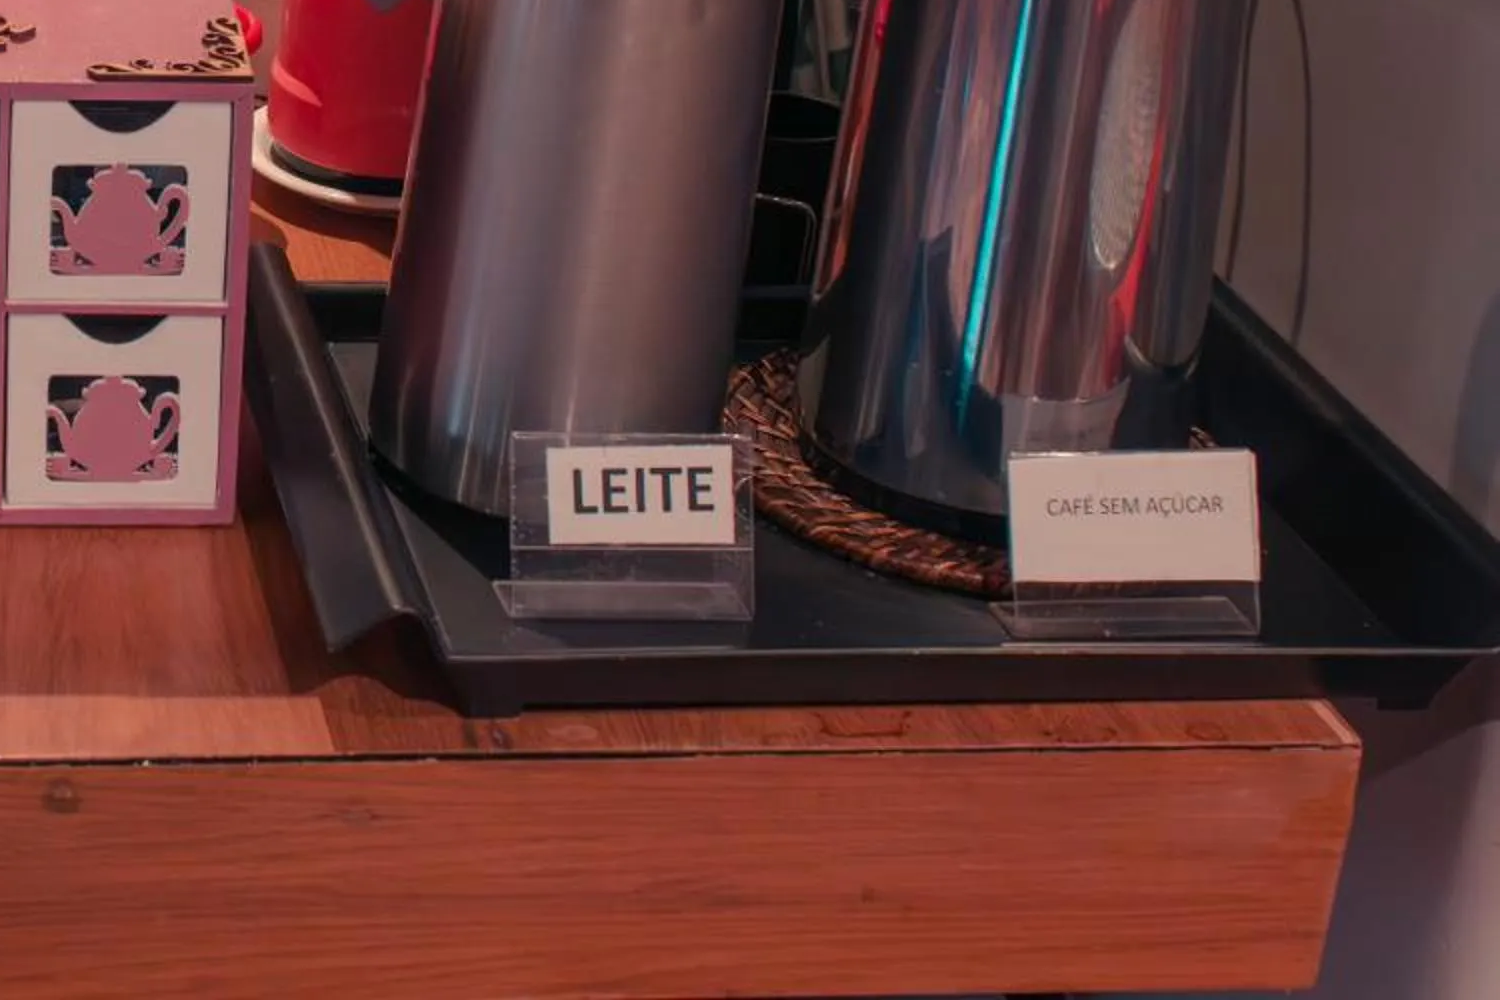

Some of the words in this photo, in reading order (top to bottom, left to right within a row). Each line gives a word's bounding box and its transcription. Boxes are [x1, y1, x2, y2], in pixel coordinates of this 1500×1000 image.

[572, 466, 715, 514] LEITE
[1046, 494, 1094, 516] CAFÉ
[1099, 496, 1140, 515] SEM
[1146, 492, 1224, 518] AÇÚCAR
